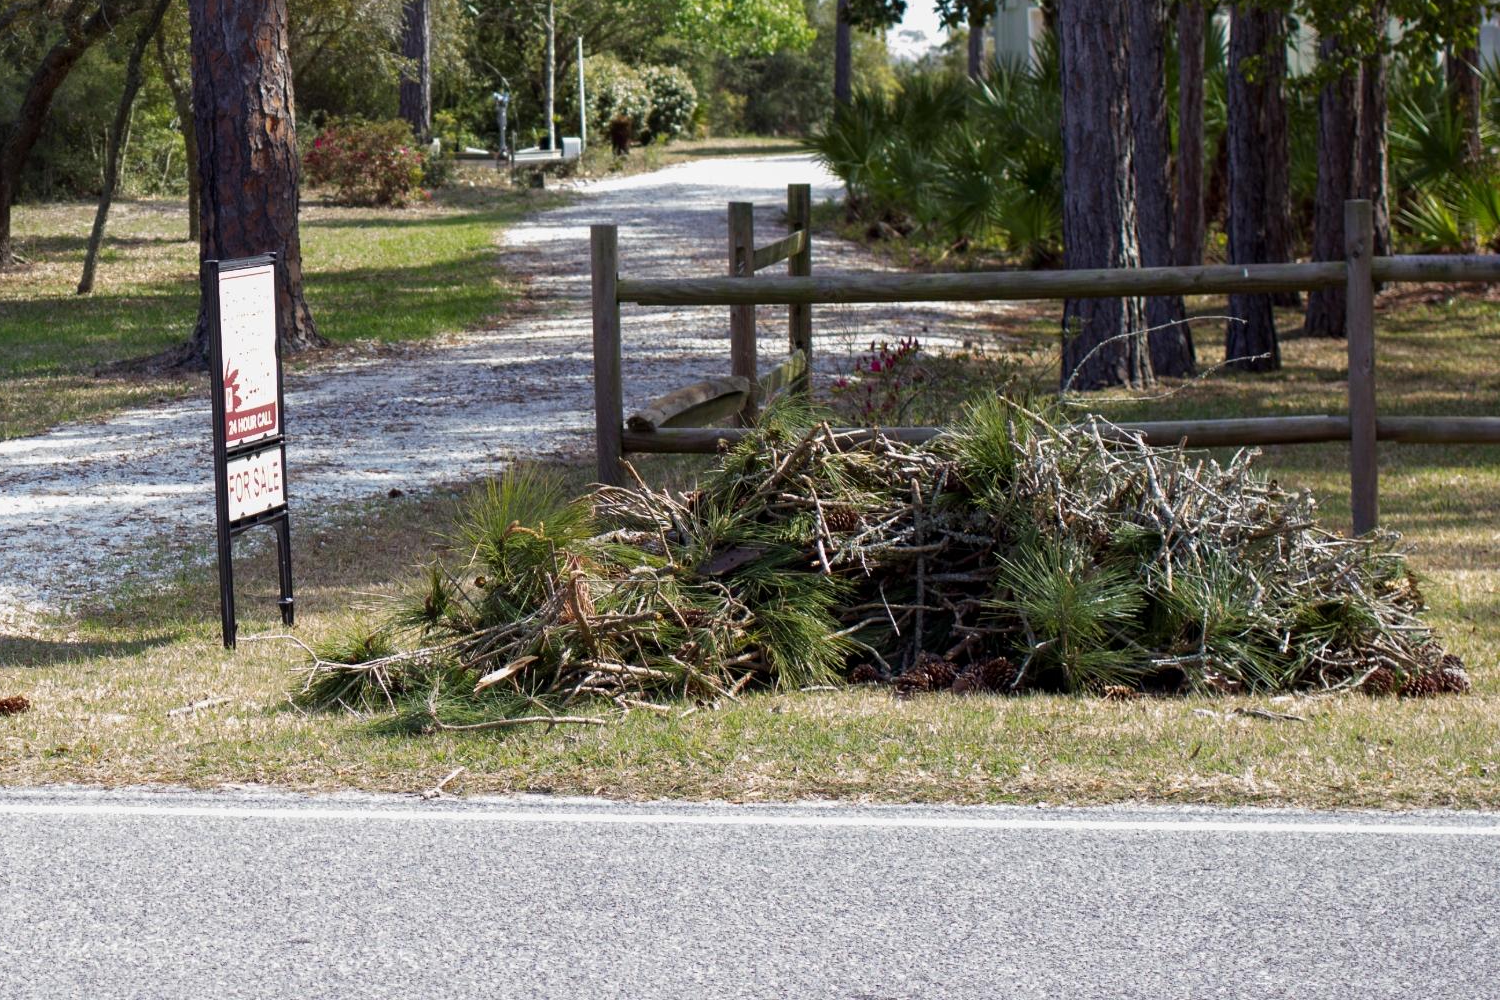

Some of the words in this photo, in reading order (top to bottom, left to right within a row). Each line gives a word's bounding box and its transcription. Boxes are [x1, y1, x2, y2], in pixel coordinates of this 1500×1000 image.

[229, 419, 238, 435] 24
[238, 414, 257, 432] HOUR
[257, 411, 273, 428] CALL
[229, 470, 251, 504] FOR
[254, 462, 280, 497] SALE
